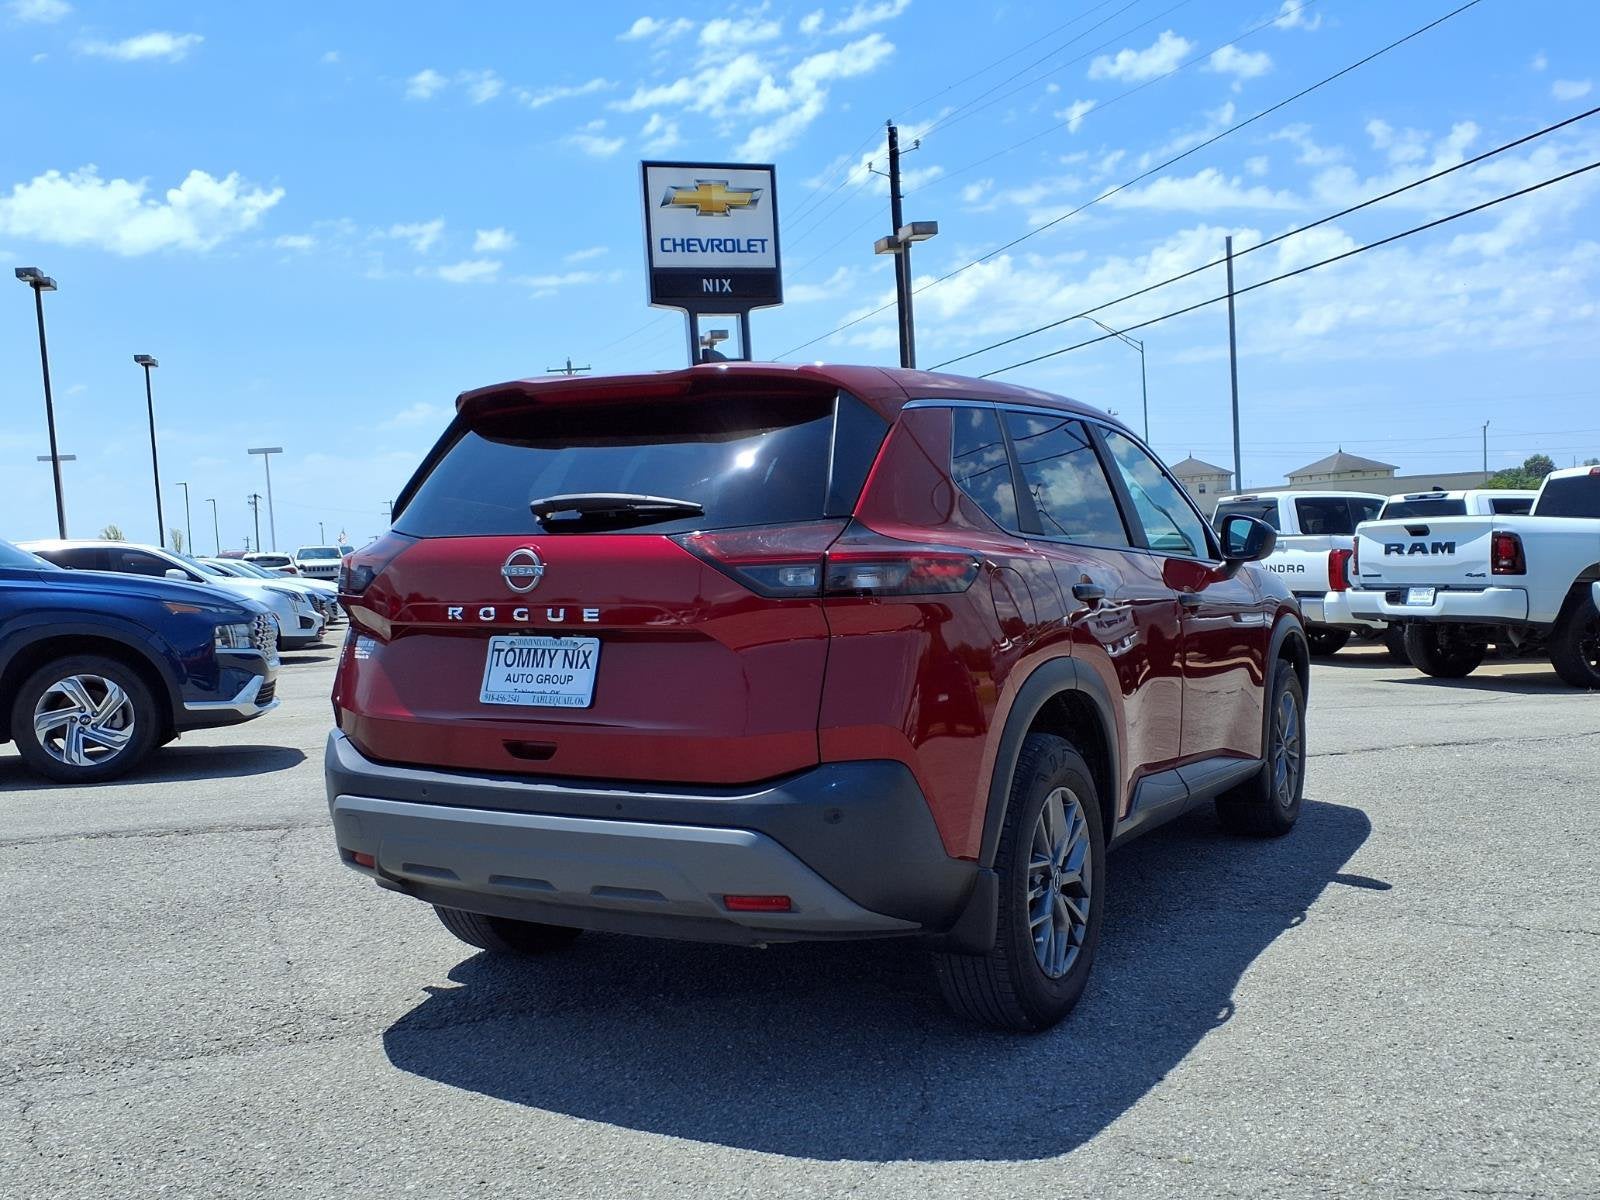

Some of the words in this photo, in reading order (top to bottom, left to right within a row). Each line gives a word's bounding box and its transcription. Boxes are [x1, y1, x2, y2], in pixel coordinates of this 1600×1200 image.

[660, 237, 768, 254] CHEVROLET
[702, 278, 733, 292] NIX
[1384, 541, 1456, 556] RAM
[502, 566, 543, 576] NISSAN
[1265, 564, 1305, 573] NDRA
[447, 606, 600, 622] ROGUE
[494, 648, 559, 668] TOMMY
[562, 649, 593, 670] NIX
[504, 673, 534, 684] AUTO
[536, 674, 574, 685] GROUP
